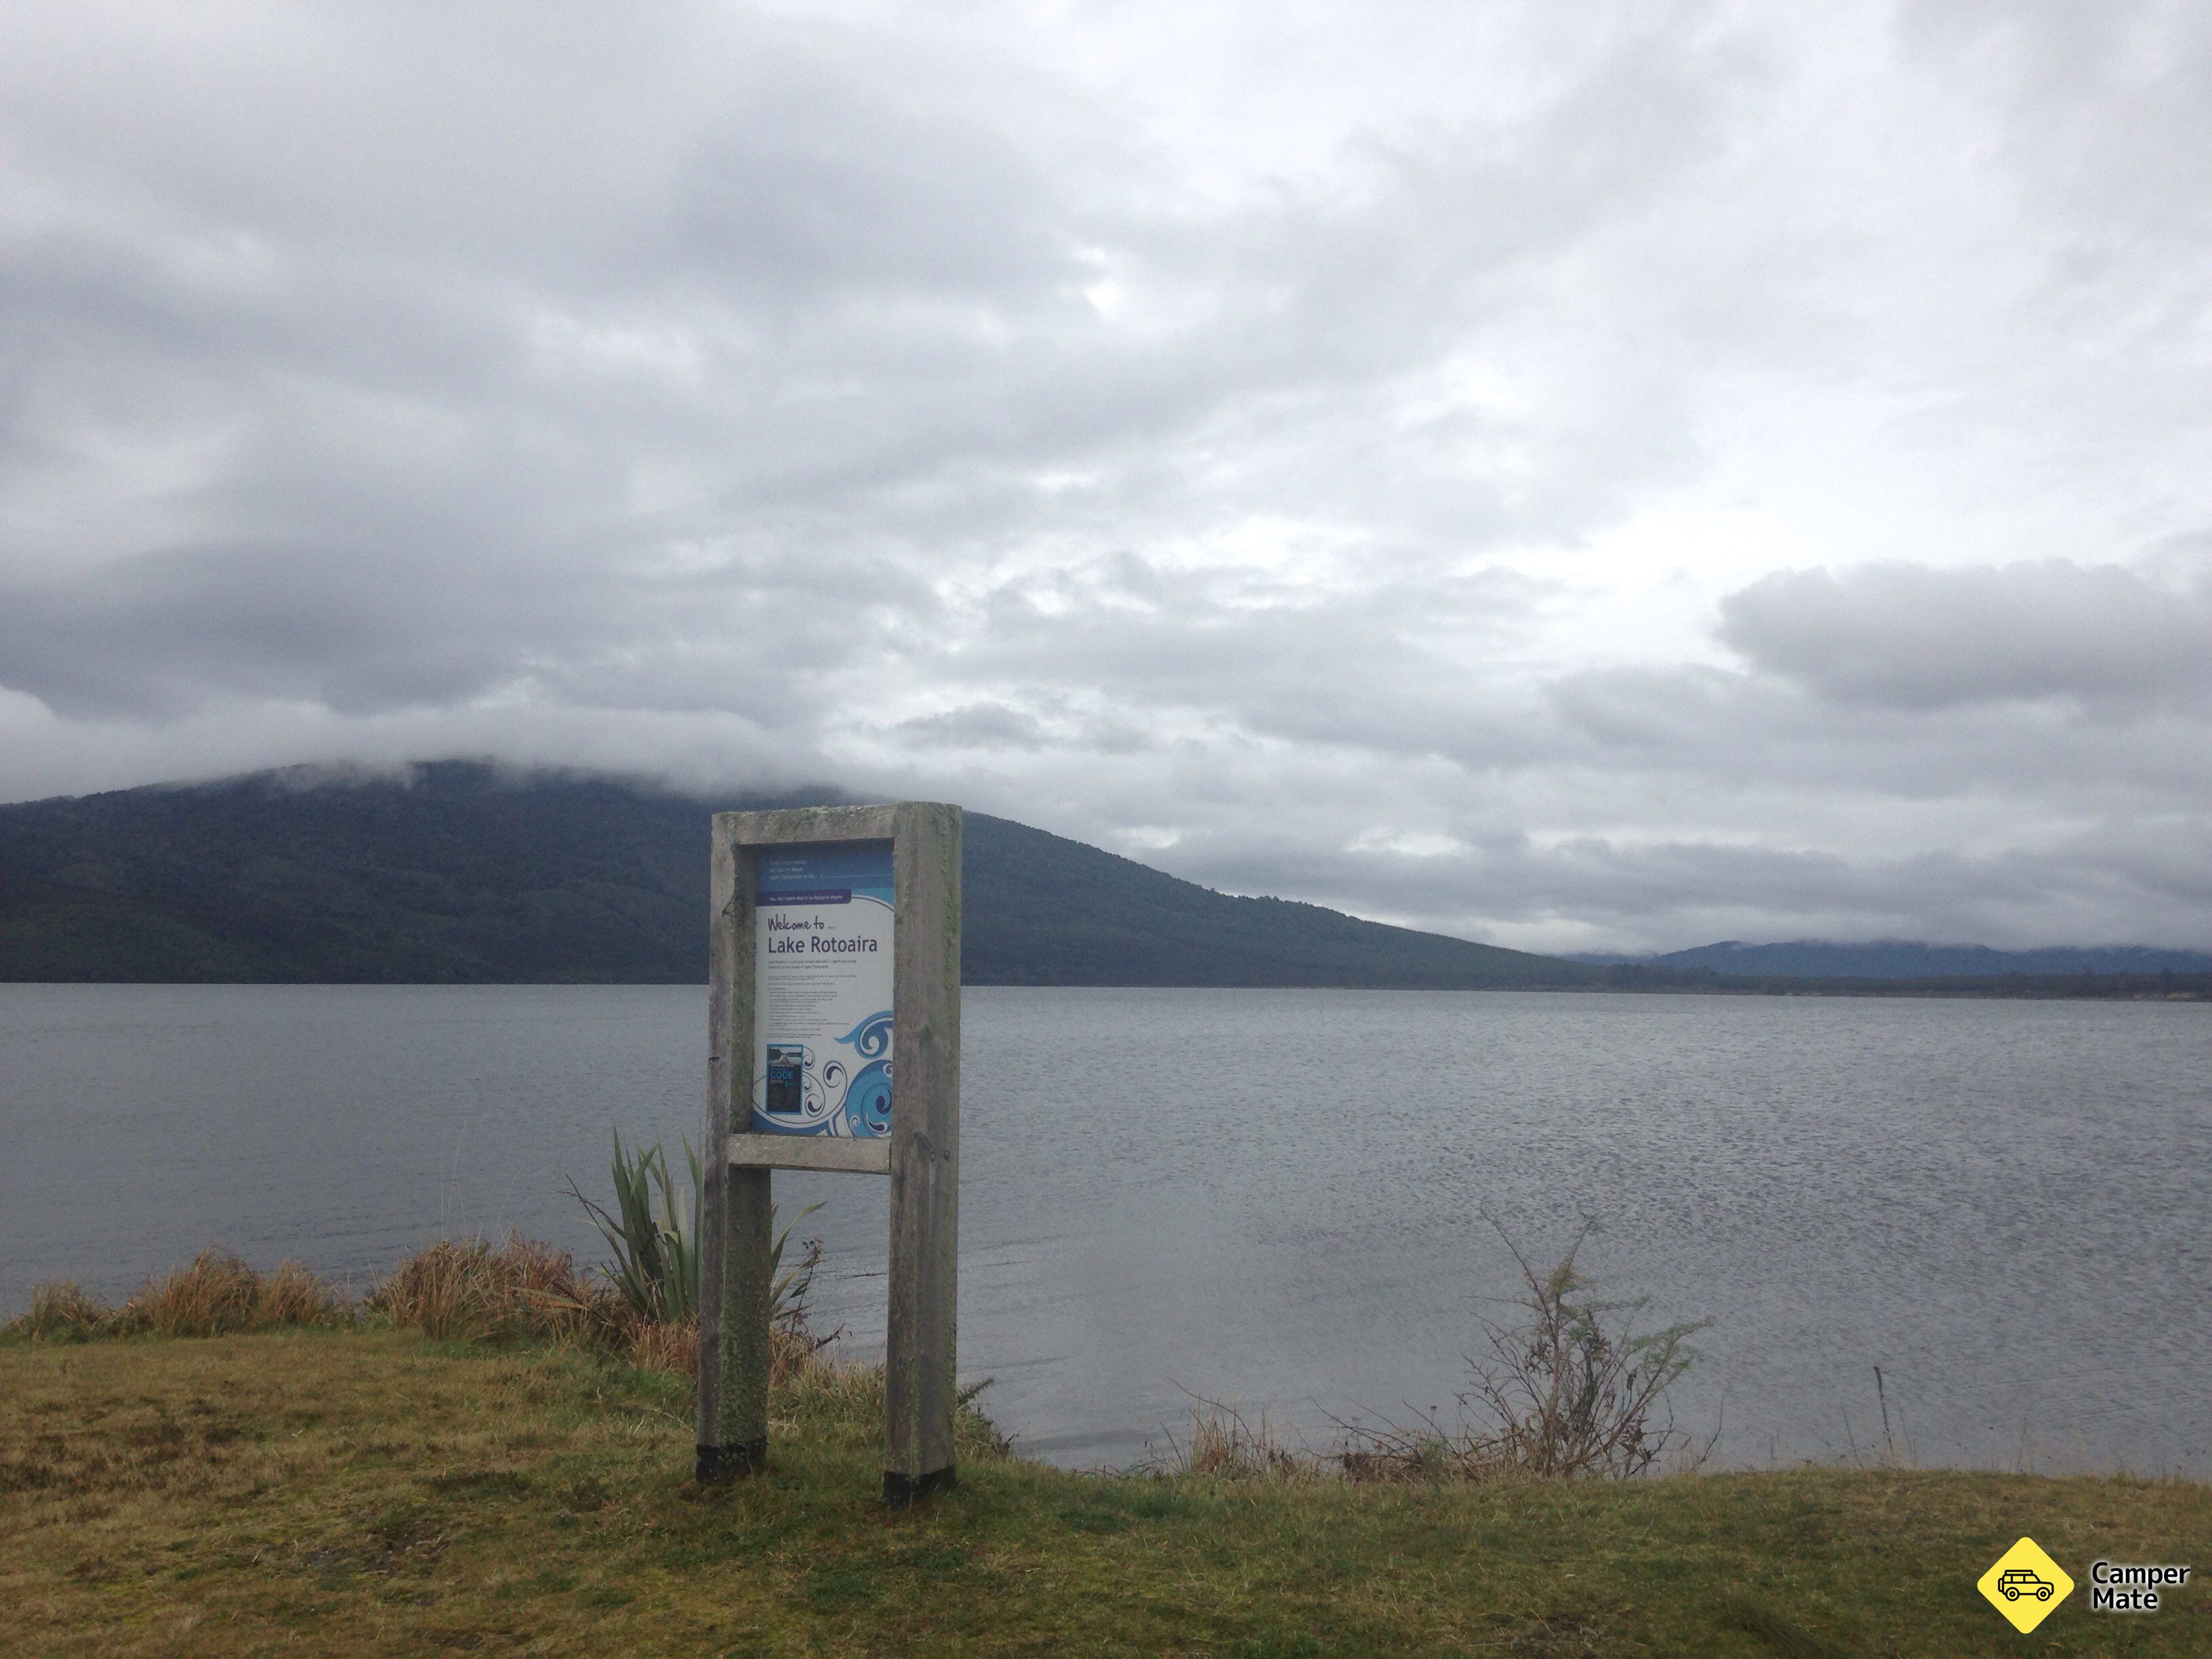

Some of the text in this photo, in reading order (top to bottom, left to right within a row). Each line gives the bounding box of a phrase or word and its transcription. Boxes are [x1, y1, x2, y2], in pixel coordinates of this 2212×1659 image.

[768, 914, 812, 931] Welcome
[768, 935, 878, 954] Lake Rotoaira
[770, 1071, 794, 1080] CODE
